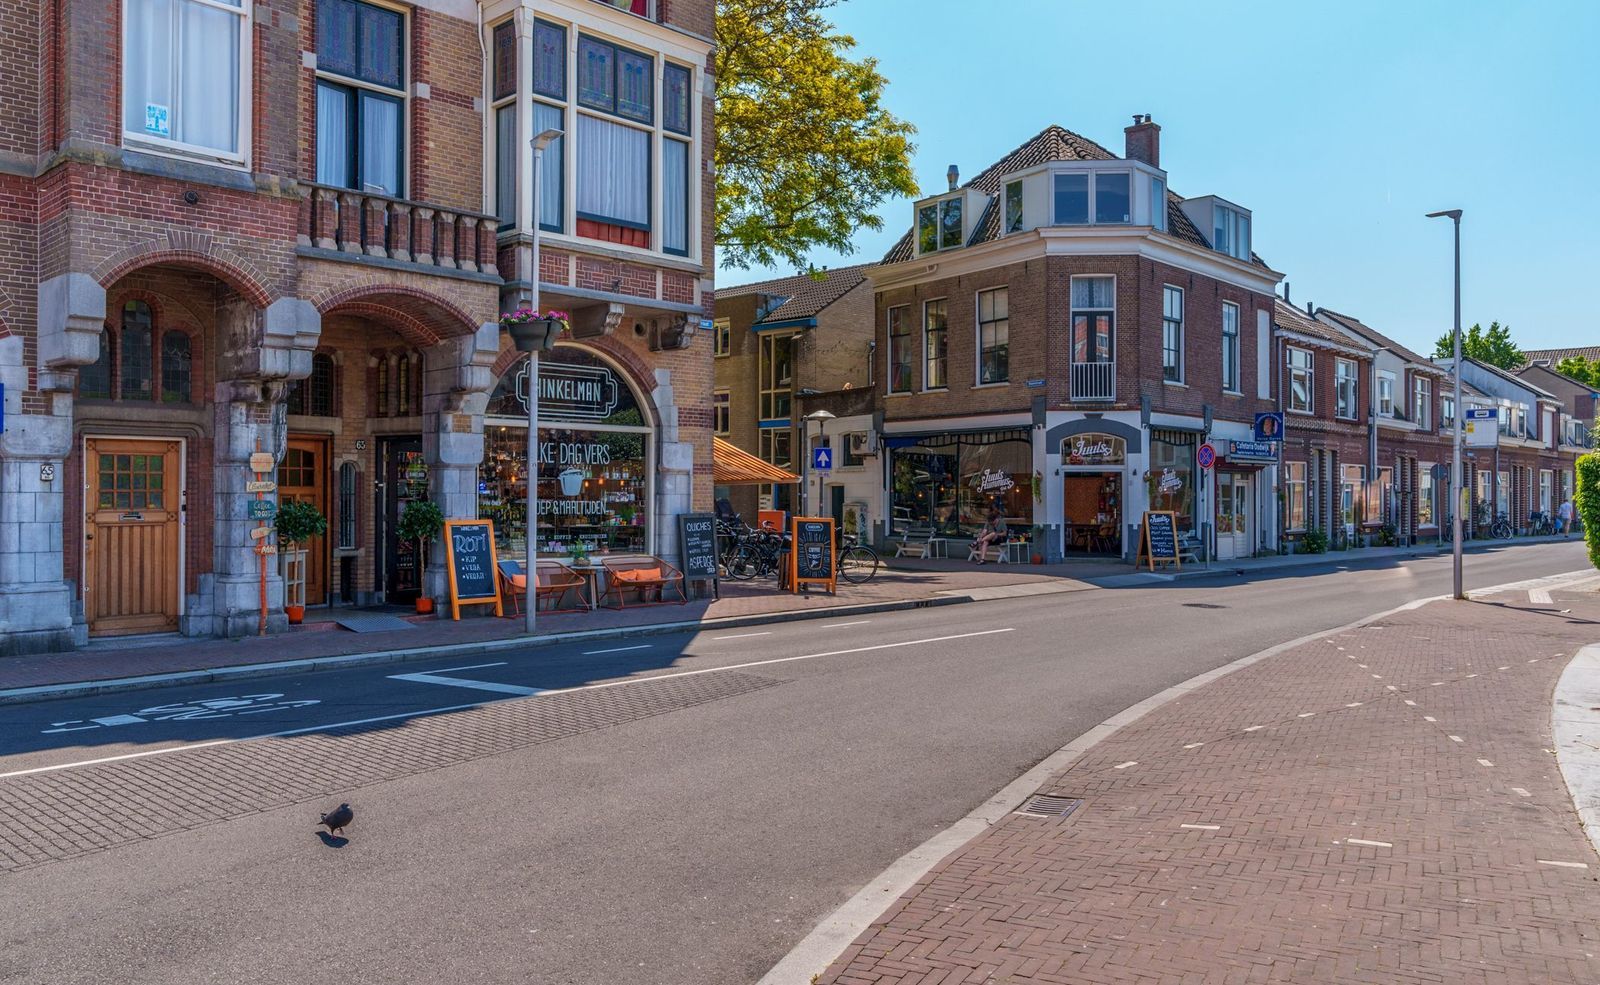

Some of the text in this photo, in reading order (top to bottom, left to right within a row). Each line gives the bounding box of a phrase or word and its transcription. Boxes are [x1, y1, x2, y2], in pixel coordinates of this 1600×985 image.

[560, 442, 582, 465] DAG
[584, 443, 611, 466] VERS
[41, 465, 54, 476] 65
[552, 500, 560, 515] &
[560, 500, 606, 516] MAALTIJDEN
[689, 555, 715, 569] ASPERGE
